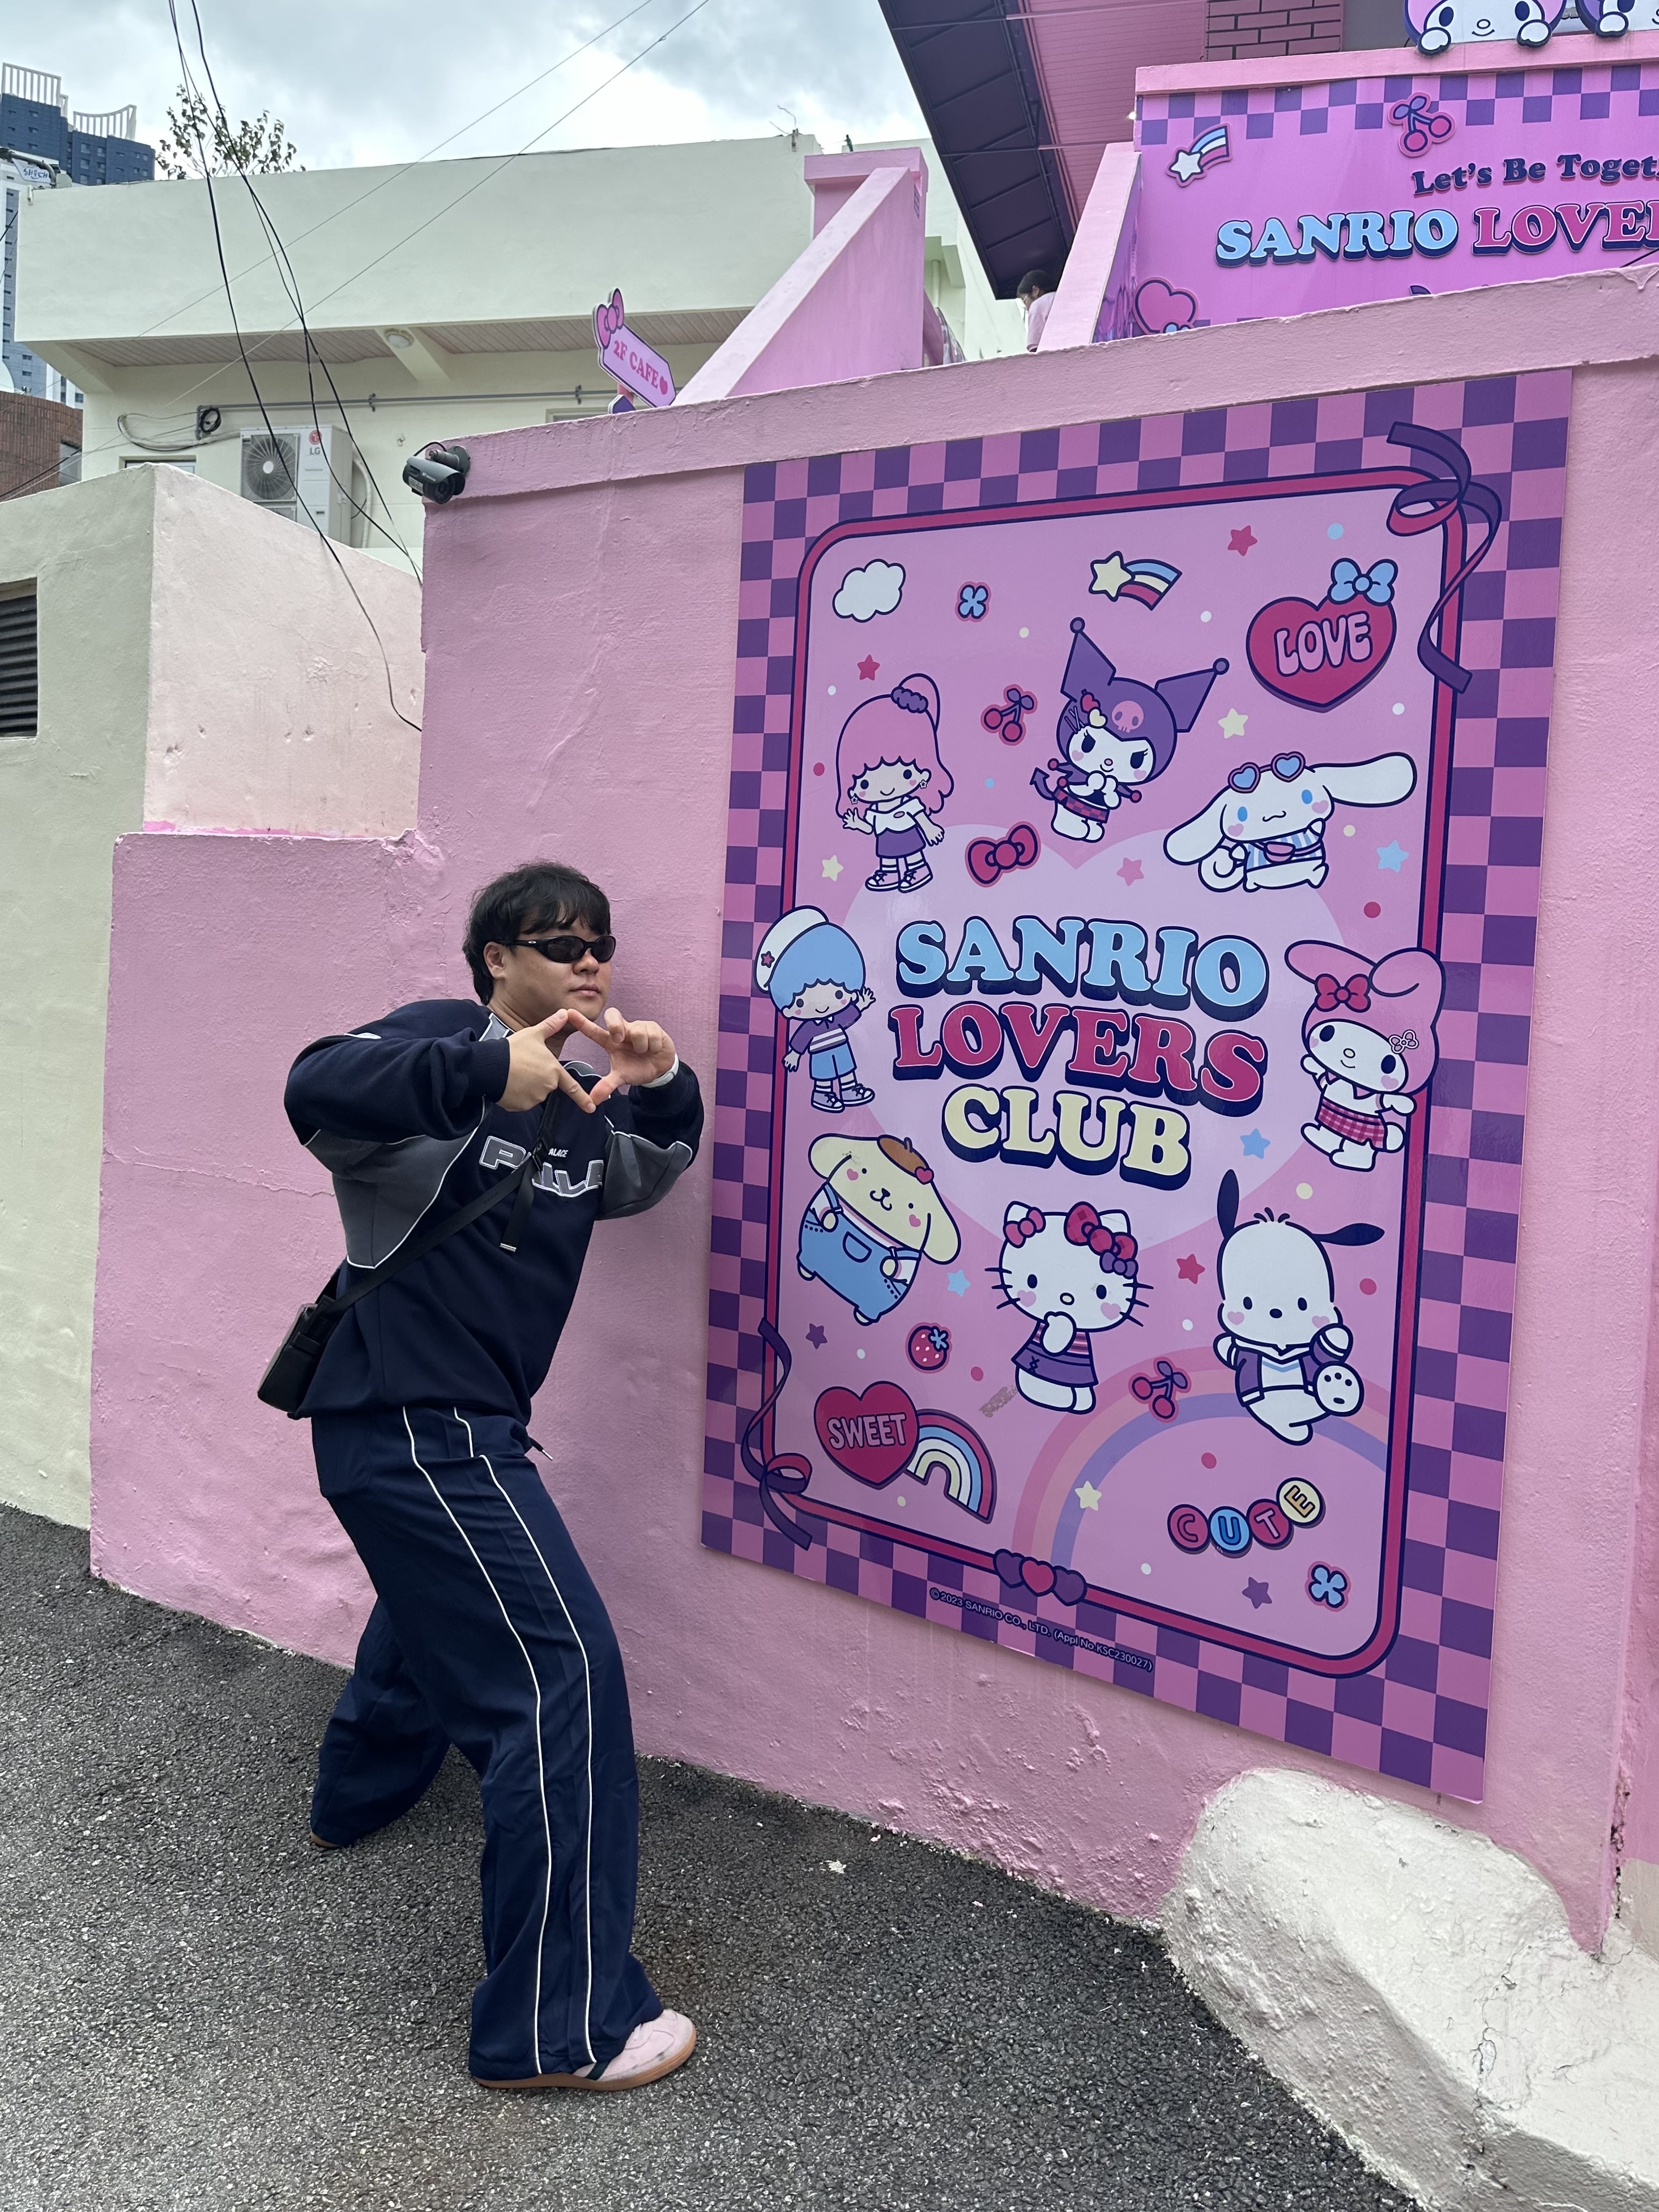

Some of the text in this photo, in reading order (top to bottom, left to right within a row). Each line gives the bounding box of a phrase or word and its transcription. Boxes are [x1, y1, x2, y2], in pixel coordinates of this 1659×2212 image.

[1503, 157, 1546, 182] Be
[1557, 154, 1659, 183] Toget
[1216, 208, 1459, 266] SANRIO
[613, 340, 659, 389] 2F CAFE
[1273, 610, 1373, 677] LOVE
[895, 916, 1269, 1022] SANRIO
[888, 1000, 1269, 1118] LOVERS
[548, 1148, 569, 1158] ALACE
[941, 1084, 1191, 1191] CLUB
[827, 1412, 906, 1450] SWEET
[1176, 1484, 1316, 1546] CUTE
[940, 1592, 963, 1606] 2023
[965, 1600, 1003, 1619] SANRIO
[1029, 1620, 1051, 1636] LTD.
[1054, 1629, 1078, 1646] (Appl
